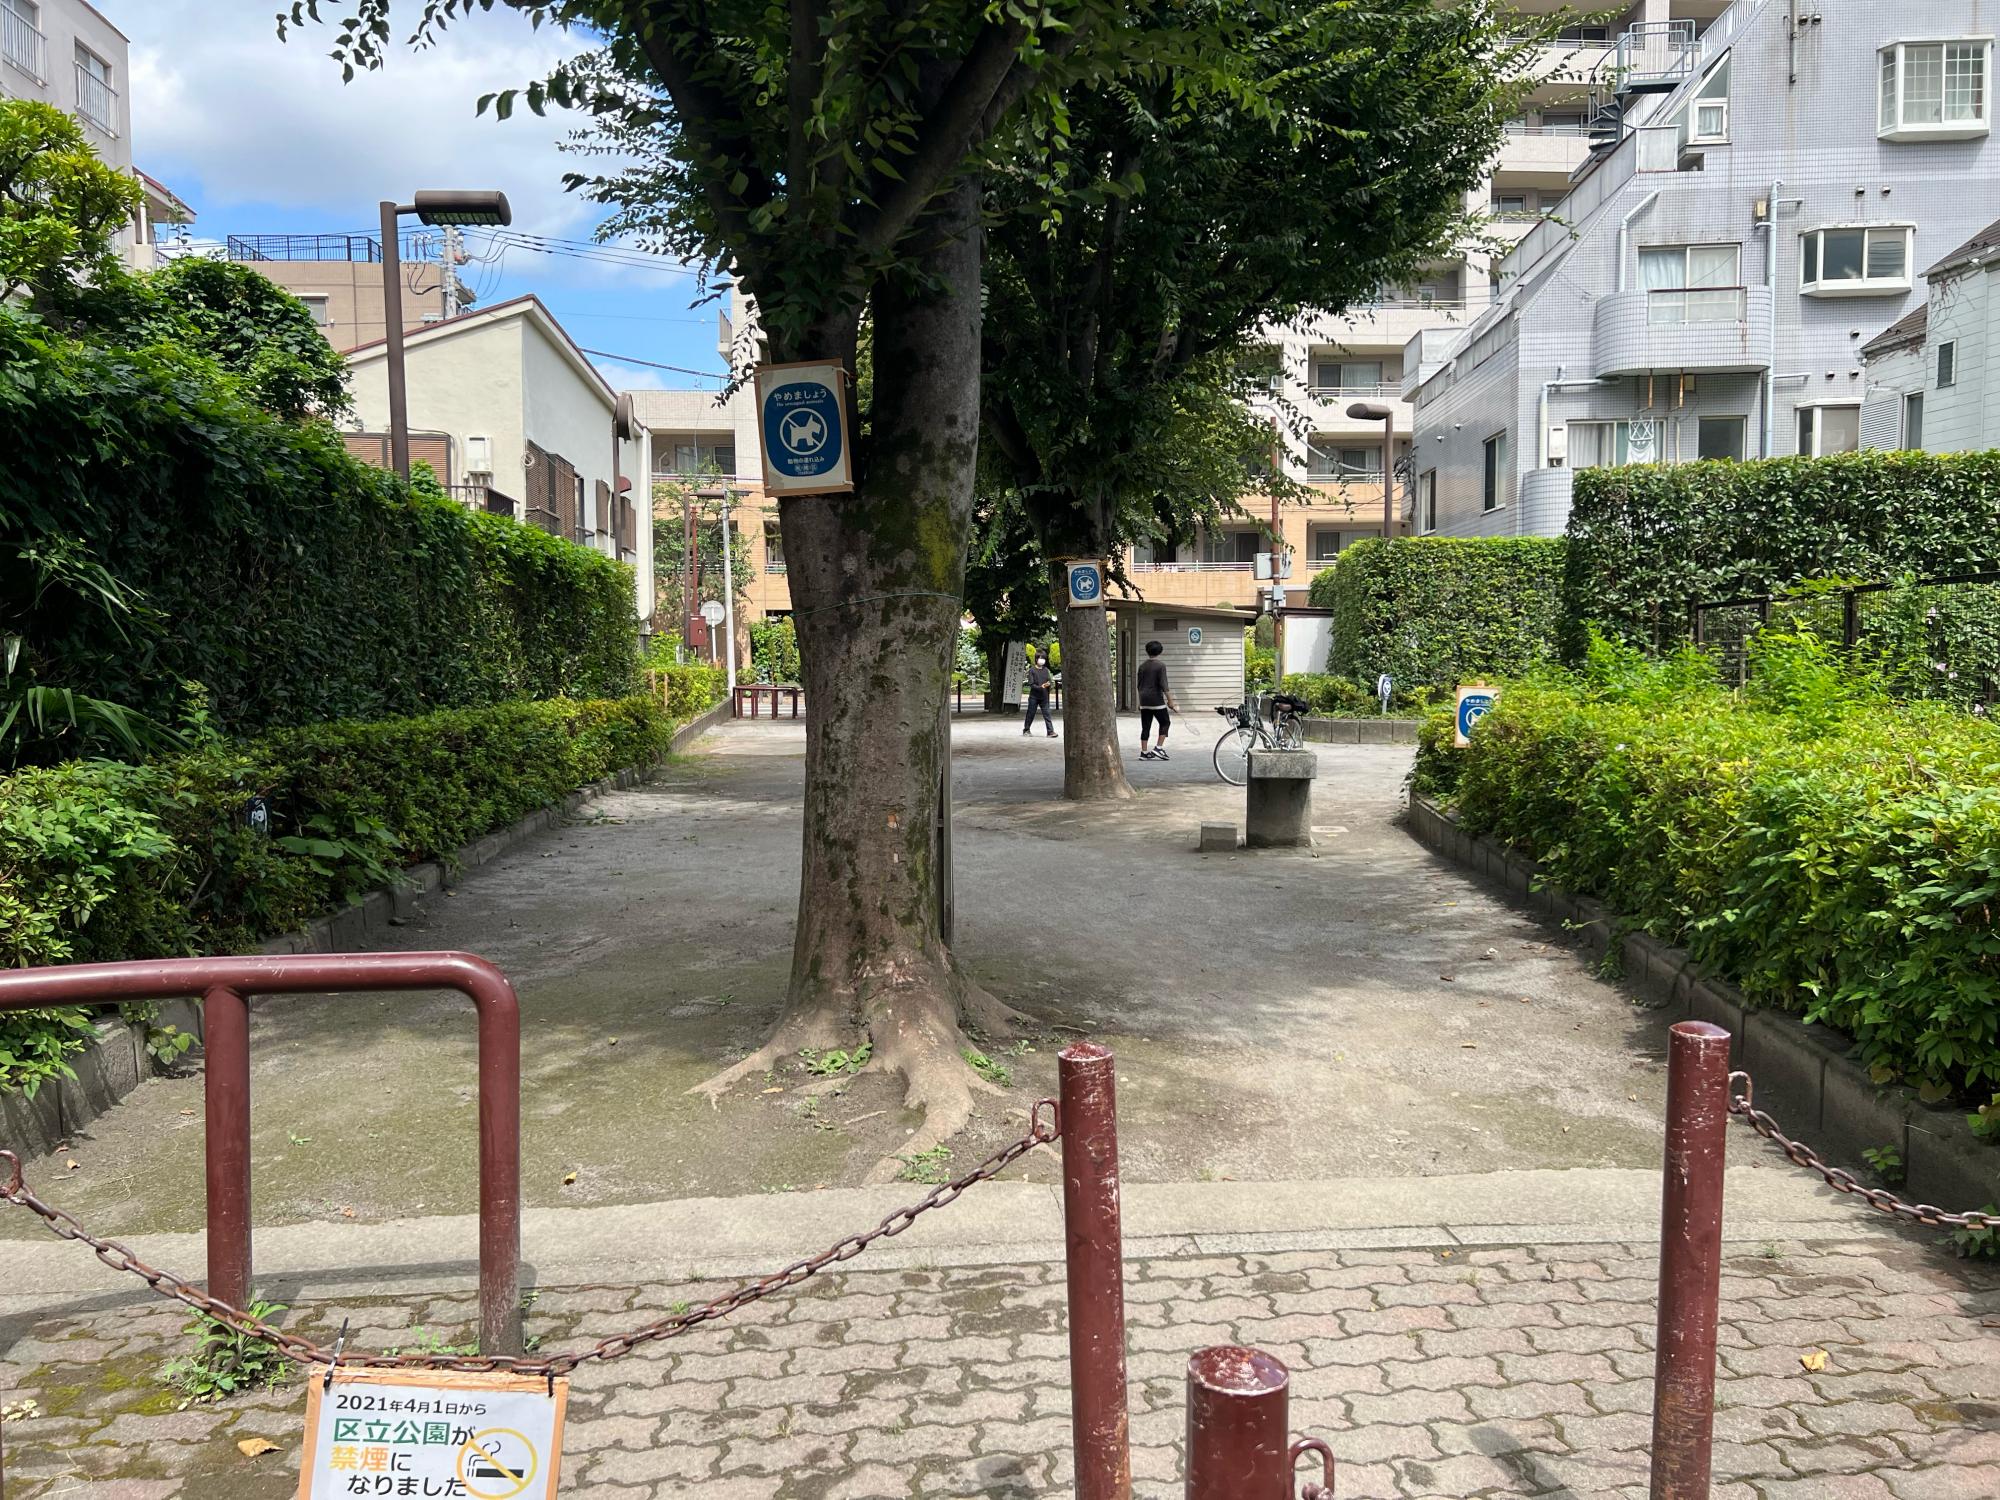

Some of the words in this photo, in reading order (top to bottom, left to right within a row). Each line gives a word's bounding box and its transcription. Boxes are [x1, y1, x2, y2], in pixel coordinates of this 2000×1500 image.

[774, 388, 827, 401] やめましょう
[336, 1394, 487, 1416] 2021年4月1日から
[333, 1418, 476, 1446] 区立公園が
[329, 1445, 413, 1472] 禁煙に
[347, 1474, 467, 1497] なりました
